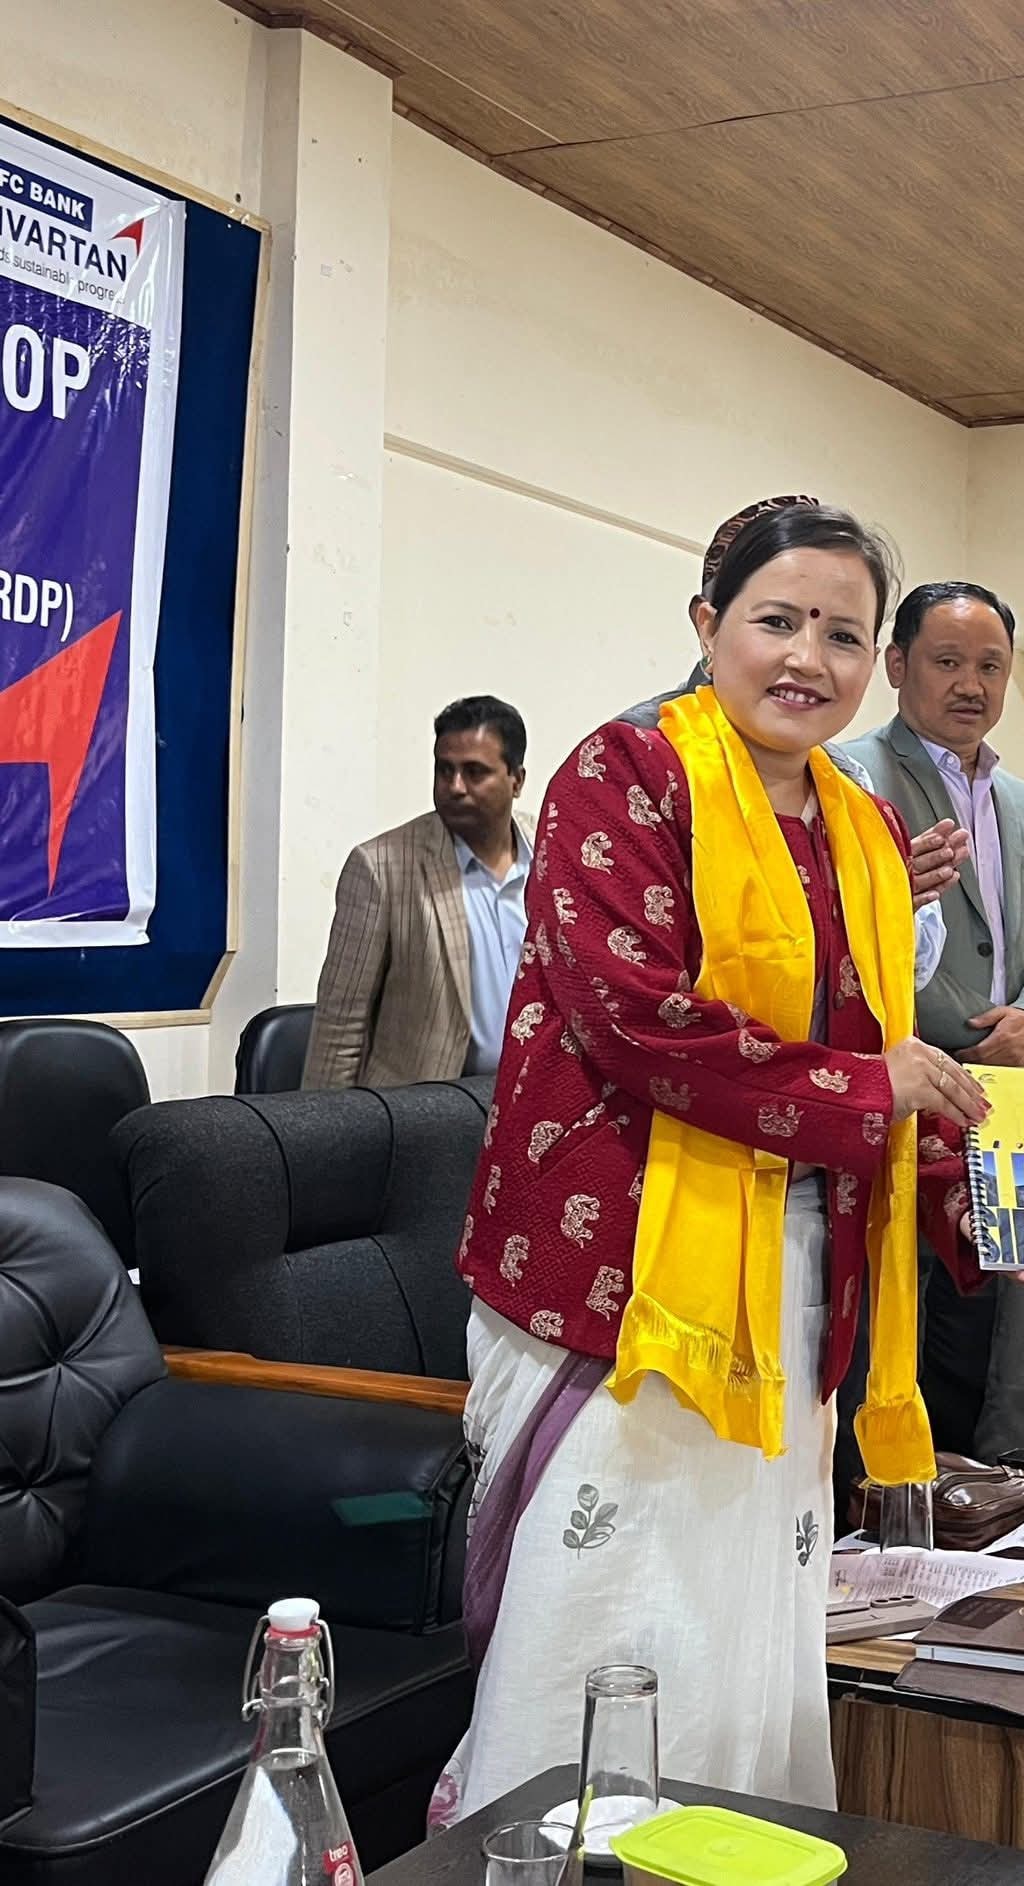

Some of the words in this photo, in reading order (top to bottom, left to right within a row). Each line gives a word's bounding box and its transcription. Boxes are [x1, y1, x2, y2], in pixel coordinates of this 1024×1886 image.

[30, 181, 86, 221] BANK
[13, 255, 75, 287] sustainabl
[78, 279, 125, 305] progre
[2, 323, 91, 420] OP
